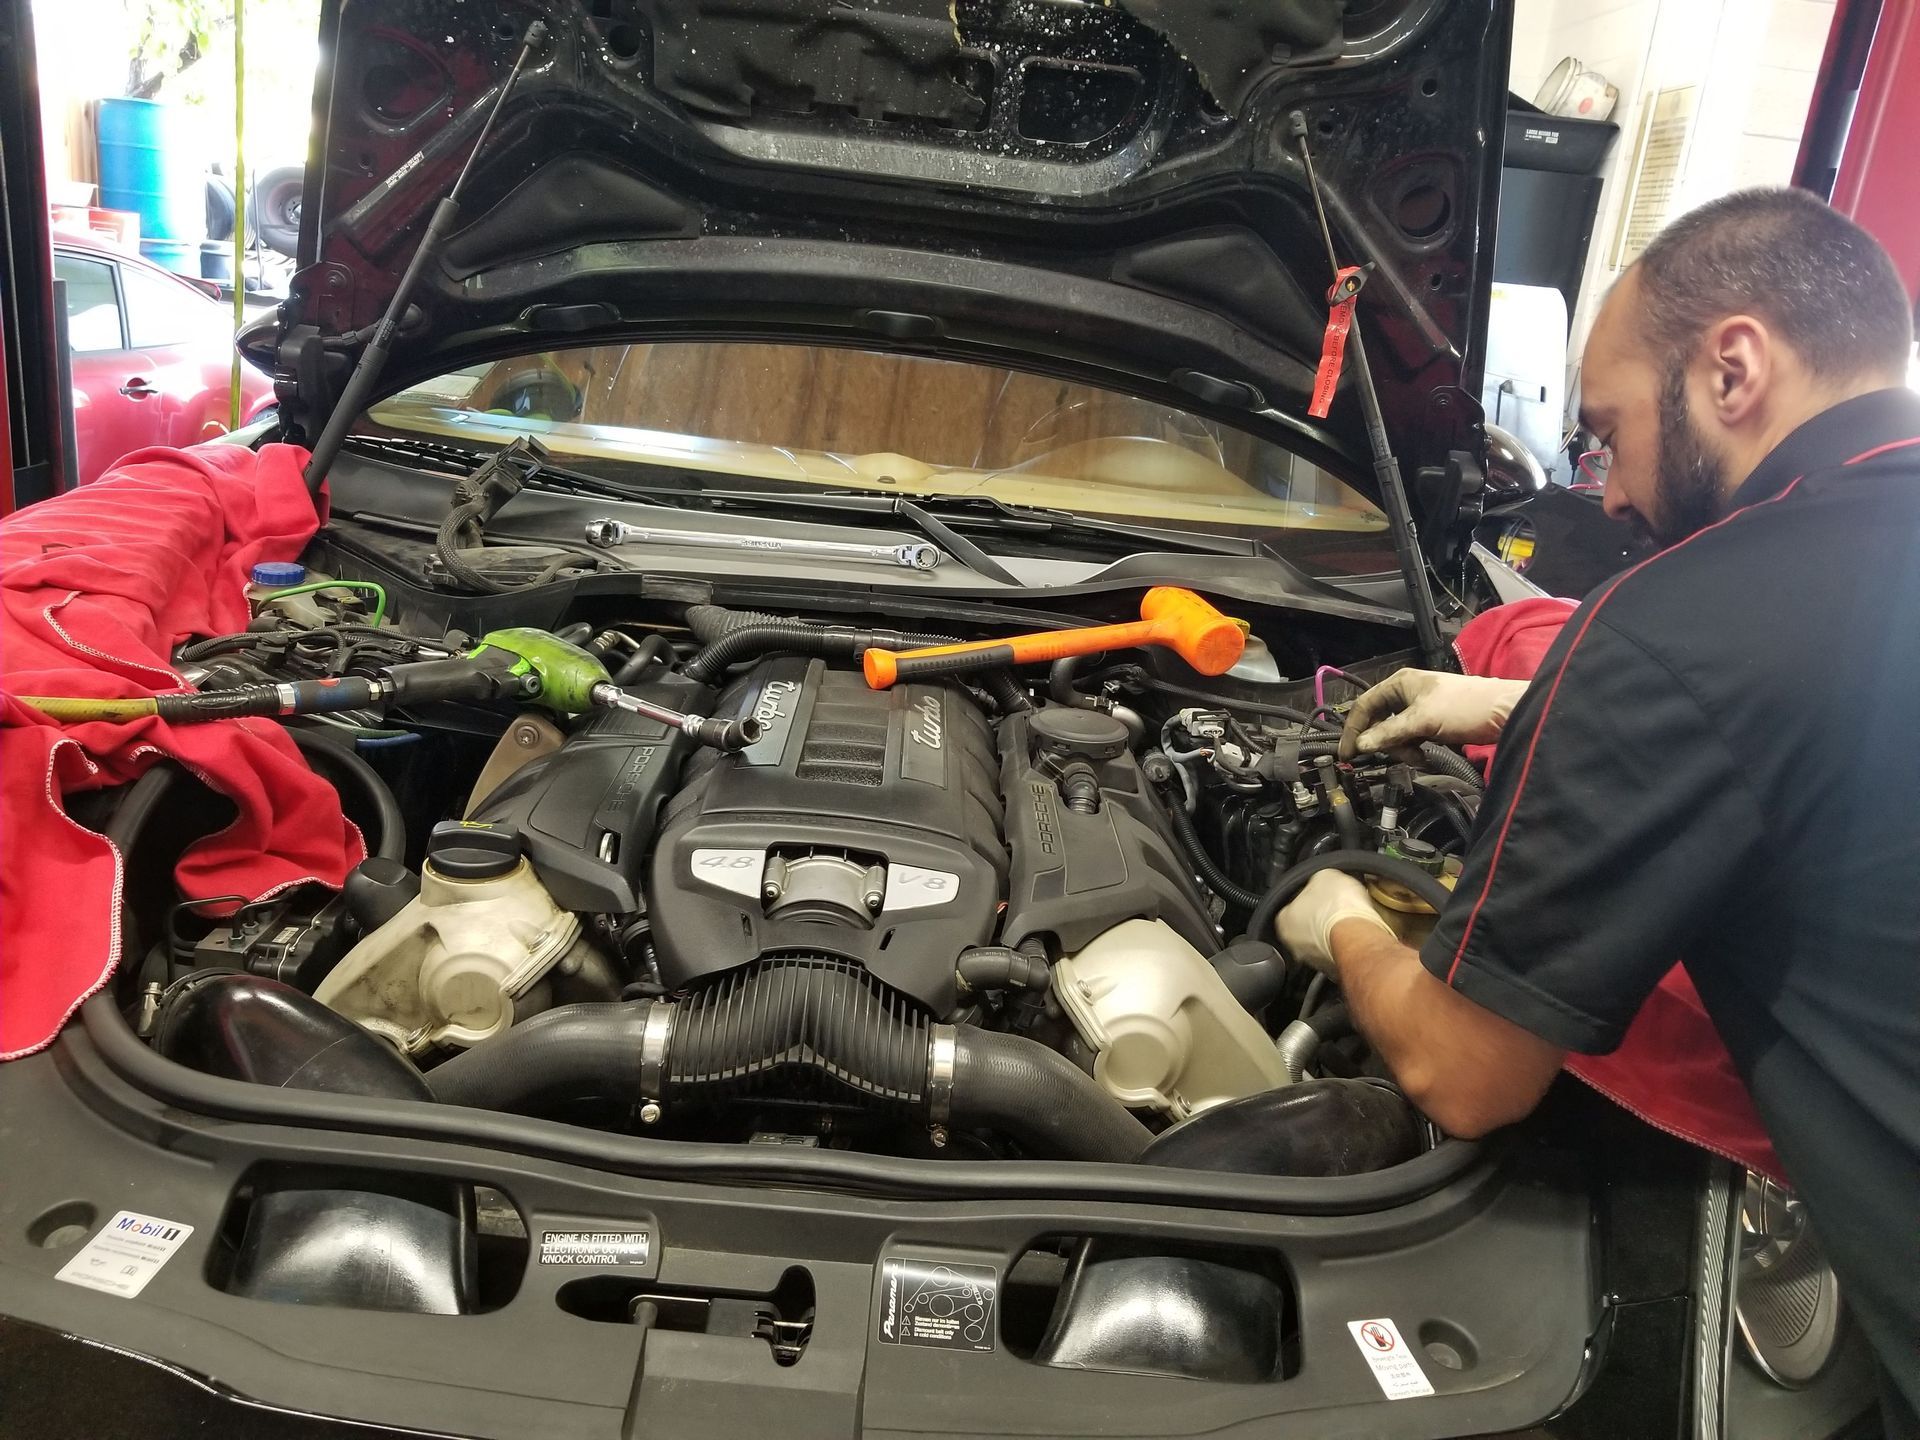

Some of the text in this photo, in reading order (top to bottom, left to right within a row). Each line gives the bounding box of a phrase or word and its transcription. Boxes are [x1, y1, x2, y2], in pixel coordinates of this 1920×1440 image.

[1329, 335, 1340, 367] BEFORE
[1319, 368, 1334, 403] CLOSING
[757, 681, 796, 730] turbo
[911, 695, 942, 749] turbo
[607, 746, 656, 811] PORSCHE
[1031, 784, 1056, 855] PORSCHE
[898, 871, 948, 891] V8
[116, 1217, 181, 1241] Mobil 1
[545, 1233, 647, 1244] ENGINE IS FITTED WITH
[541, 1254, 574, 1264] KNOCK
[576, 1255, 619, 1265] CONTROL
[543, 1243, 600, 1254] ELECTRONIC
